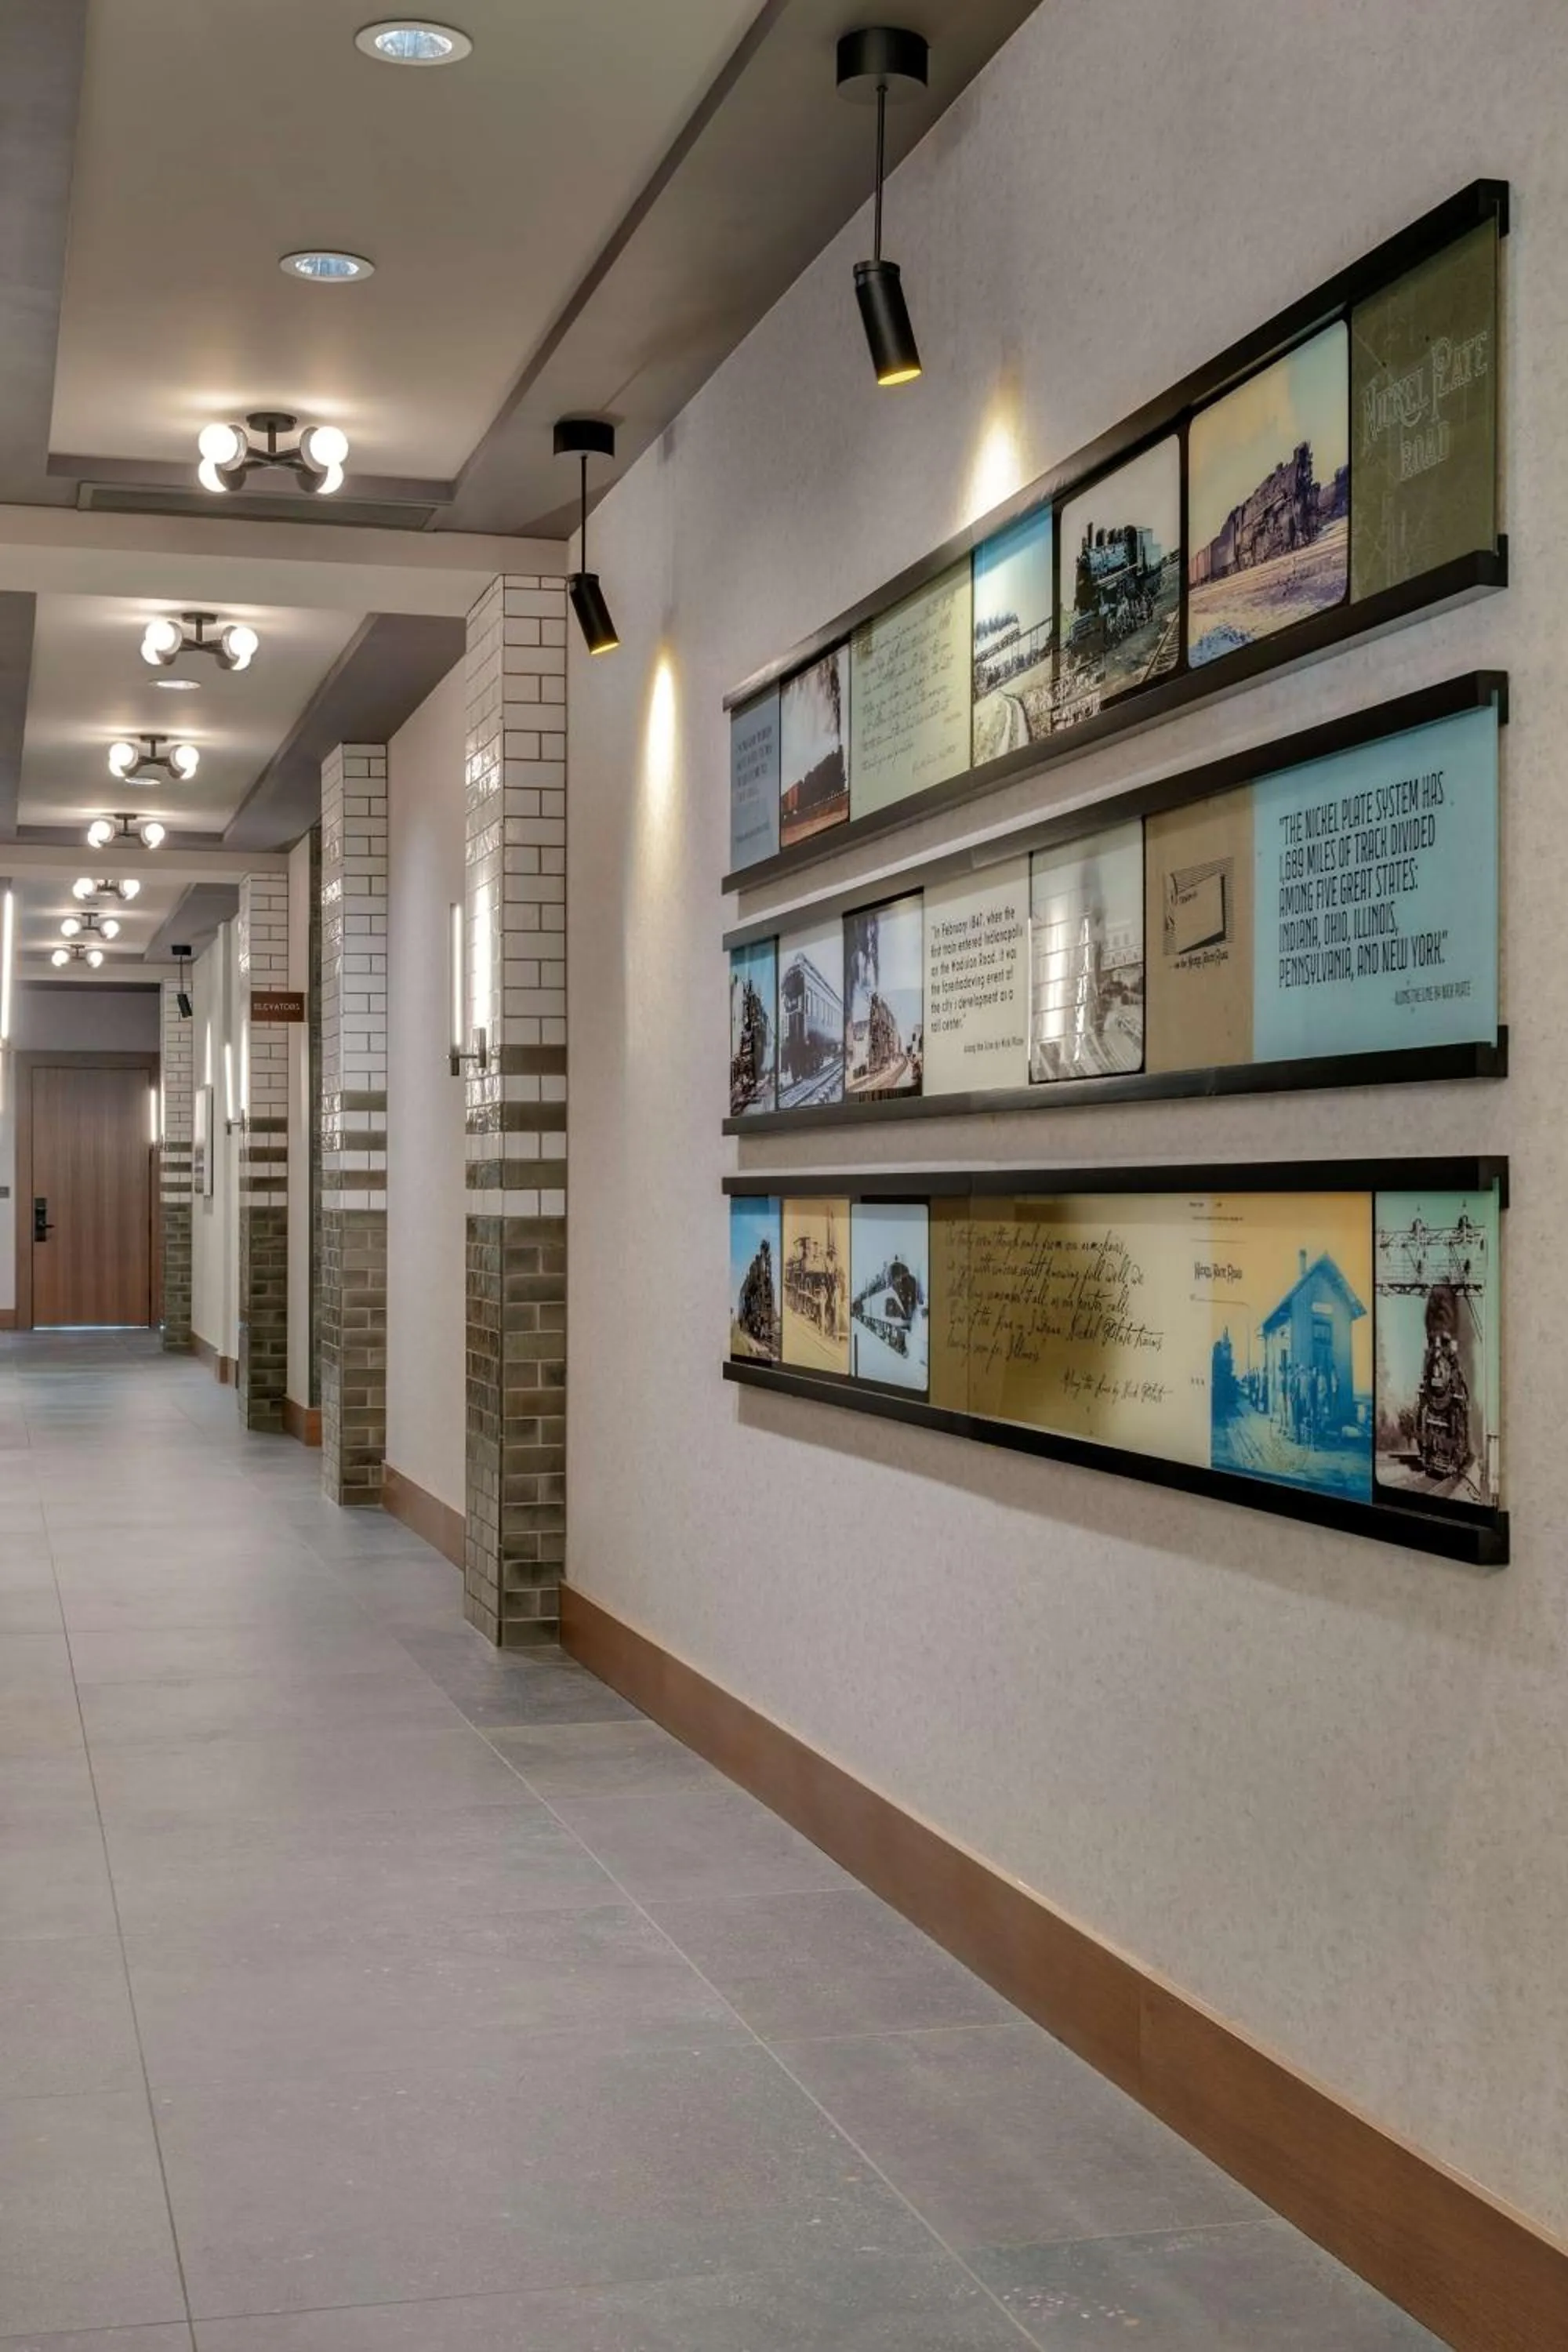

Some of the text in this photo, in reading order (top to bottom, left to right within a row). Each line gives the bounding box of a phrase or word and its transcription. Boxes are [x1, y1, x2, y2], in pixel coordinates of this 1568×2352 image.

[1400, 421, 1452, 482] ROAD
[1279, 771, 1444, 846] "THE NICKEL PLATE SYSTEM HAS
[1279, 814, 1436, 884] 1,689 MILES OF TRACK DIVIDED
[1279, 857, 1418, 918] AMONG FIVE GREAT STATES:
[931, 944, 941, 957] first
[942, 942, 956, 954] train
[958, 933, 982, 951] entered
[942, 921, 968, 937] February
[986, 909, 1003, 924] when
[1004, 906, 1015, 920] the
[1279, 901, 1399, 953] INDIANA, OHIO, ILLINOIS,
[931, 983, 940, 995] the
[942, 974, 985, 993] foreshadowing
[986, 968, 1004, 984] event
[940, 960, 949, 975] the
[951, 957, 978, 972] Madison
[1006, 948, 1017, 960] was
[1279, 947, 1354, 989] PENNSYLVANIA,
[1357, 943, 1379, 977] AND
[1382, 938, 1408, 973] NEW
[931, 1001, 940, 1014] the
[958, 990, 998, 1009] development
[1000, 989, 1007, 1001] as
[1009, 989, 1014, 1000] a
